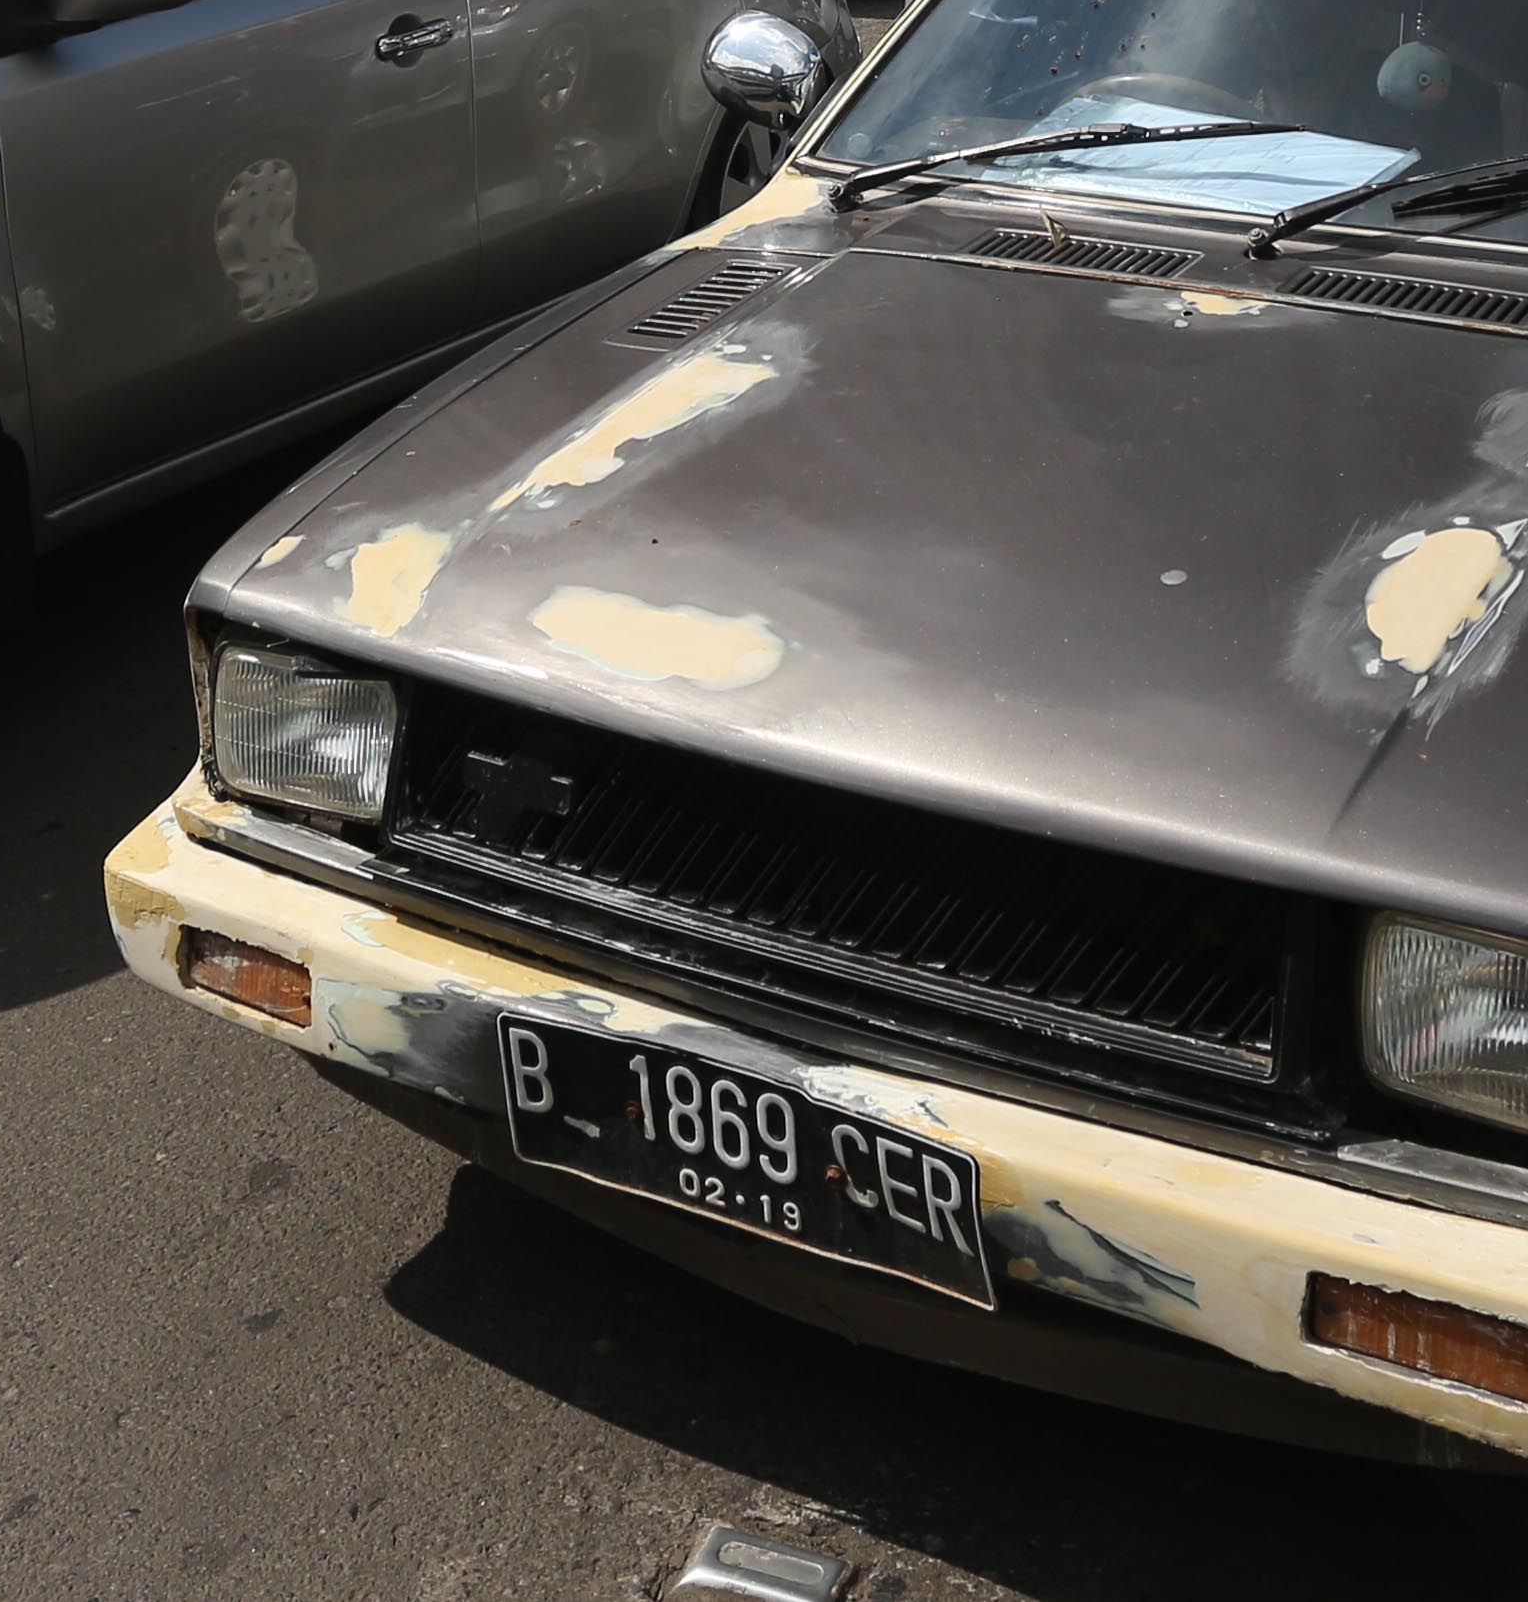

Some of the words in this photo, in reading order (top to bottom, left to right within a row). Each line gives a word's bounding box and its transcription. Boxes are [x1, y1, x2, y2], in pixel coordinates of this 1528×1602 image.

[508, 1027, 554, 1113] B
[628, 1054, 799, 1185] 1869
[830, 1123, 976, 1258] CER
